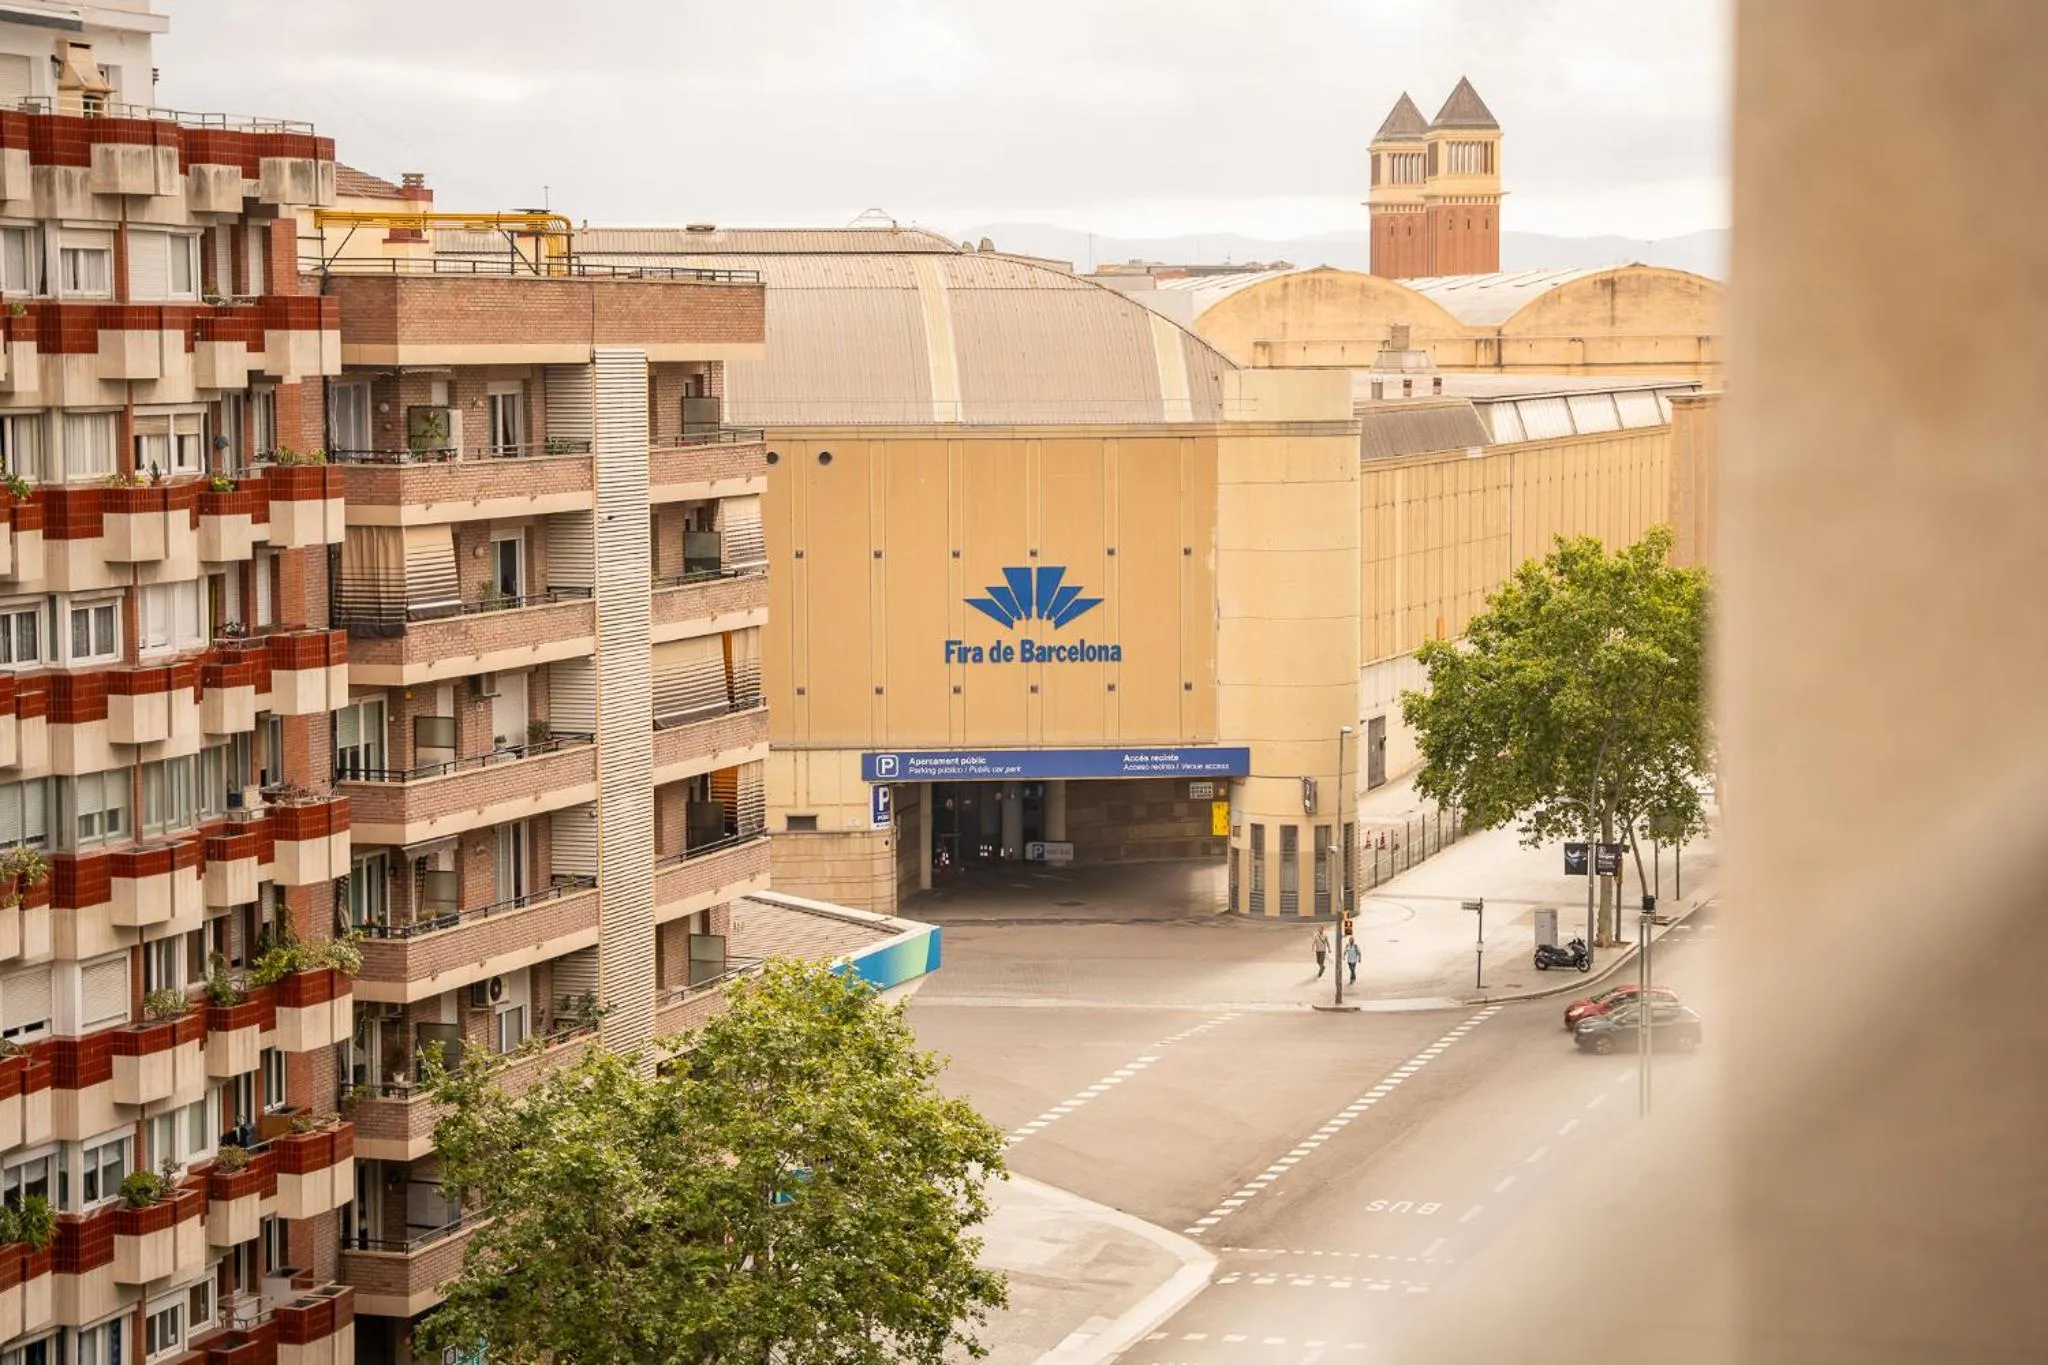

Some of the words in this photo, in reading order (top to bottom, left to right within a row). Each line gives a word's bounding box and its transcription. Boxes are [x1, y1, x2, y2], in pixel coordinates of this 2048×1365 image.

[945, 640, 984, 664] Fira
[989, 640, 1014, 663] de
[1020, 639, 1122, 663] Barcelona
[908, 757, 959, 766] Aparcament
[960, 756, 986, 766] públic
[1151, 754, 1179, 762] recinte
[881, 758, 894, 774] P
[908, 766, 936, 775] Parking
[968, 765, 990, 773] Public
[878, 787, 890, 811] P
[1366, 1200, 1443, 1215] BUS
